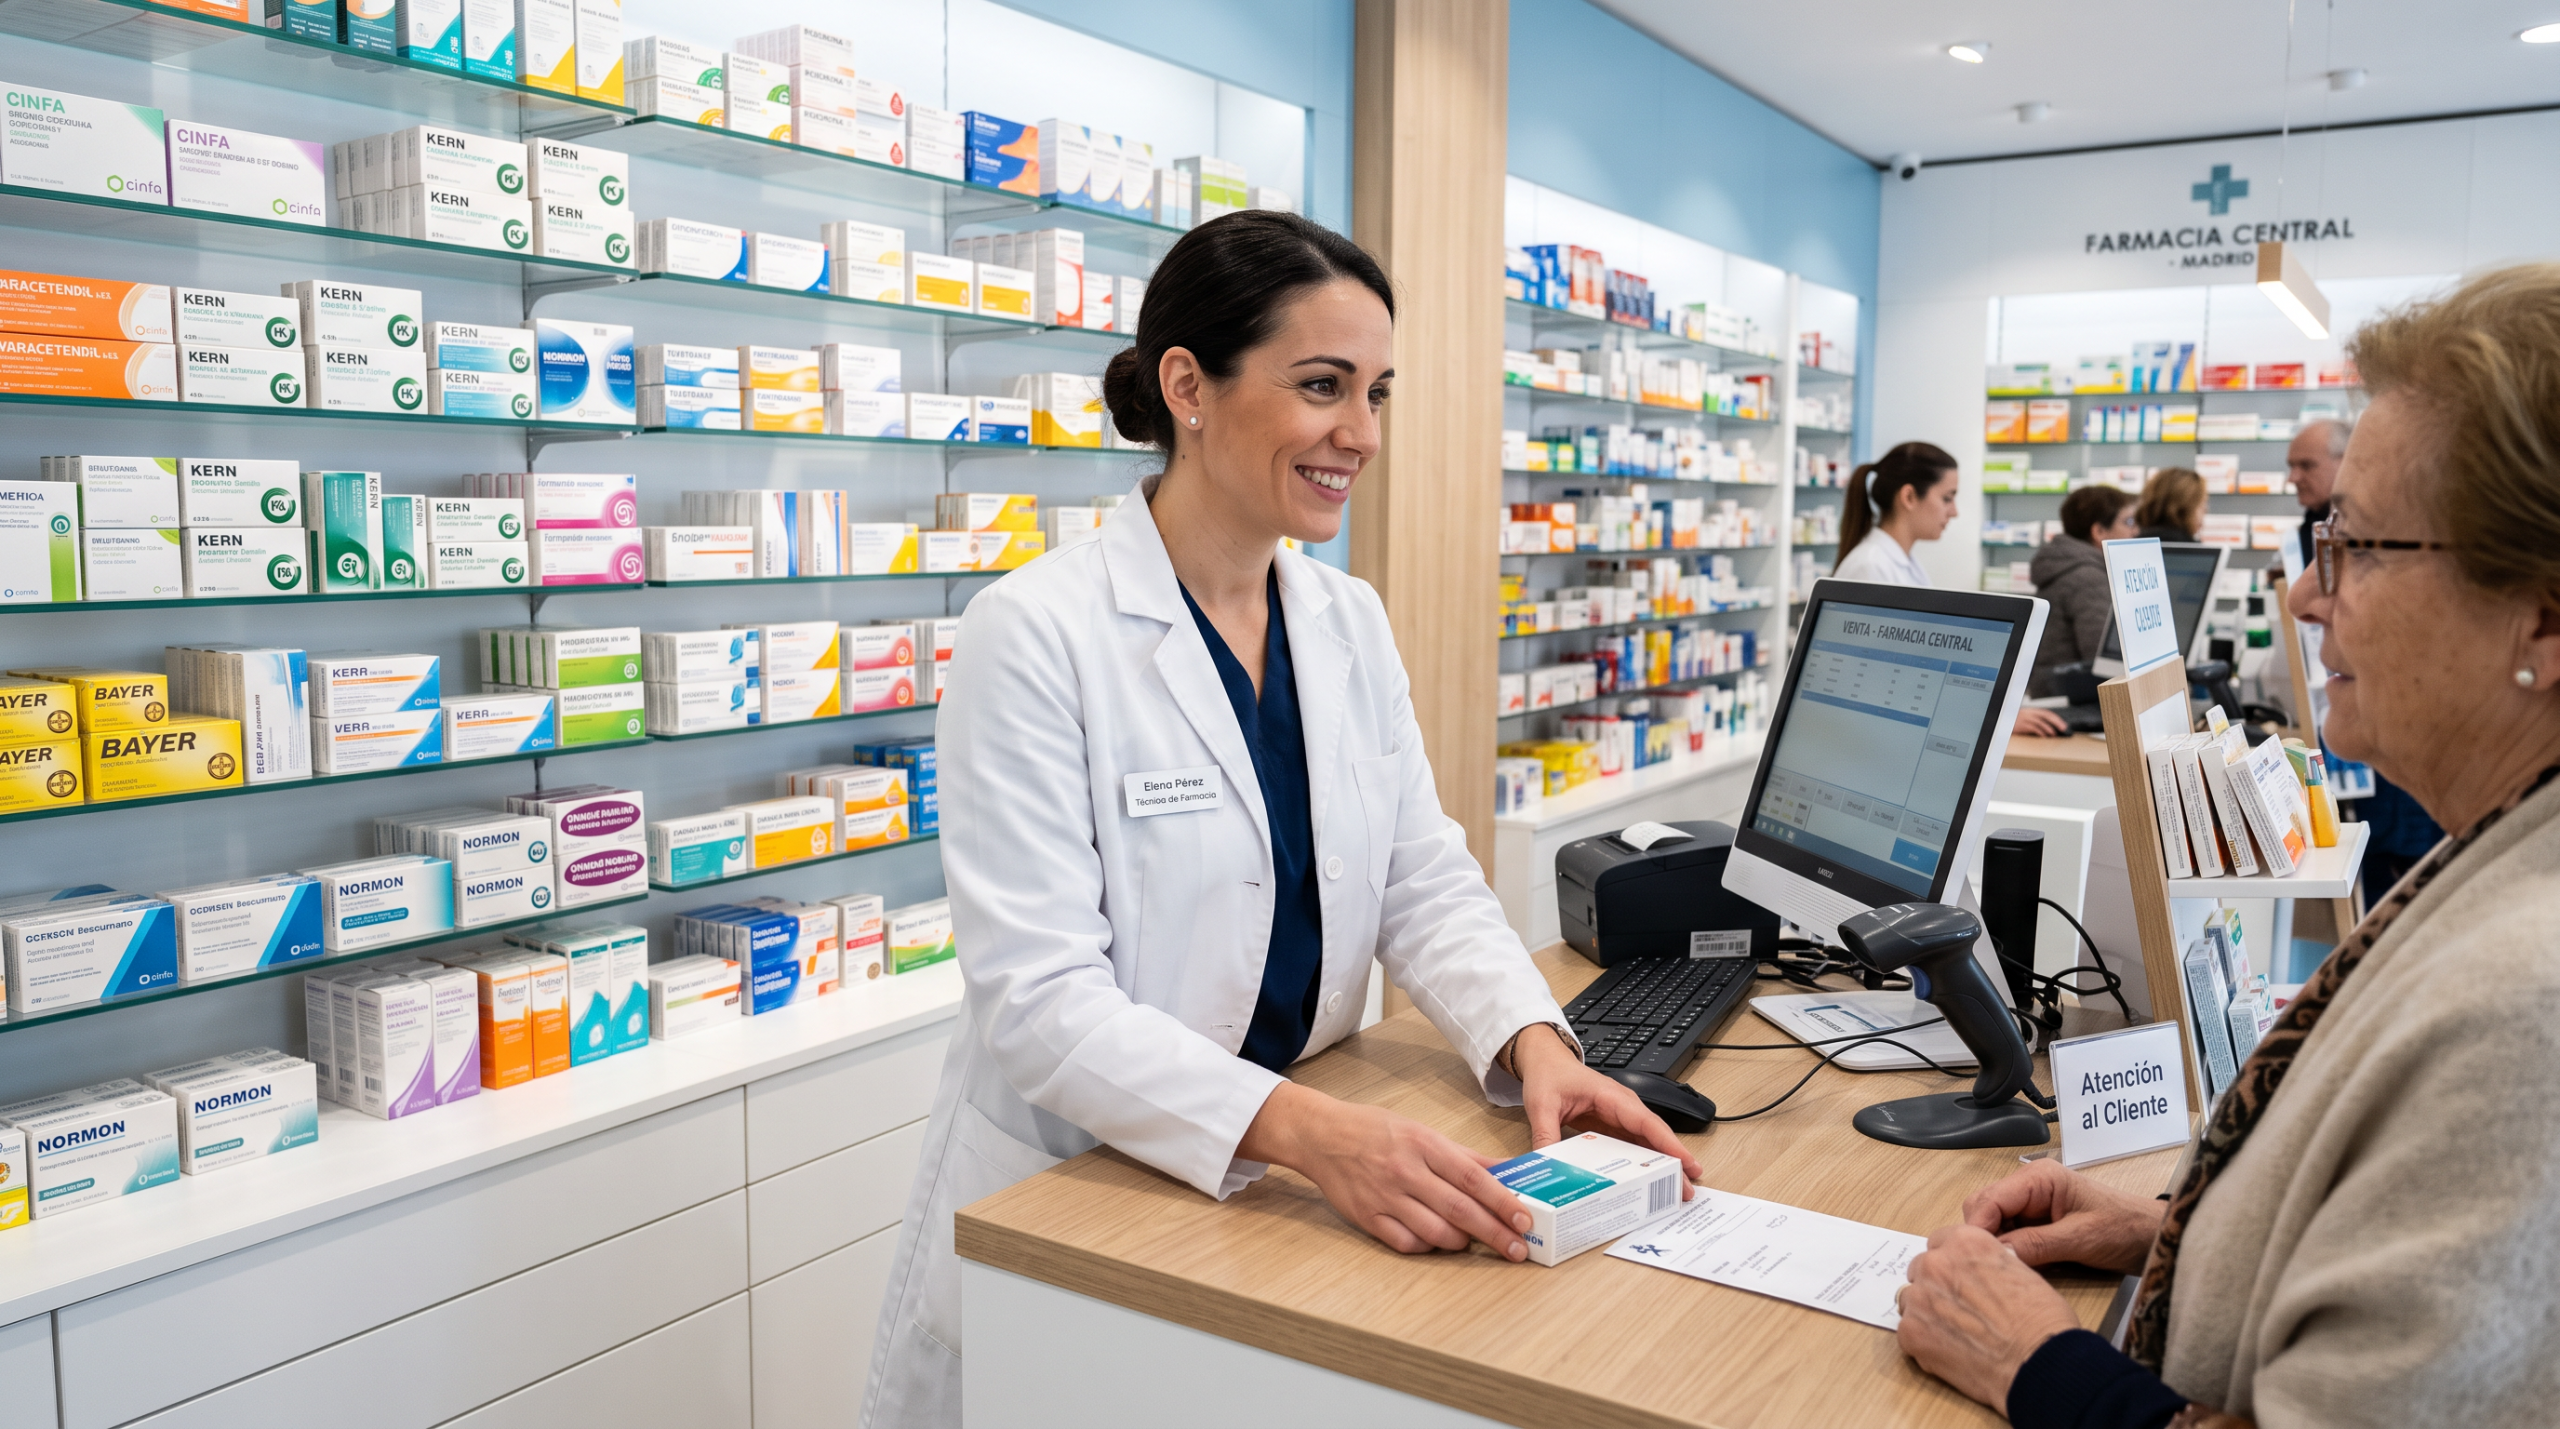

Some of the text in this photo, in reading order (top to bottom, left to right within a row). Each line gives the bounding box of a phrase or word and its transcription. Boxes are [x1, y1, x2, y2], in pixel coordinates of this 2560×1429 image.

[6, 91, 66, 114] CINFA
[177, 129, 230, 149] CINFA
[427, 133, 465, 150] KERN
[543, 145, 578, 161] KERN
[126, 179, 162, 194] cinfa
[431, 191, 469, 208] KERN
[289, 202, 321, 217] cinfa
[548, 205, 583, 220] KERN
[2085, 218, 2355, 253] FARMACIA CENTRAL
[2181, 252, 2255, 270] MADRID
[184, 293, 225, 308] KERN
[320, 287, 363, 302] KERN
[441, 325, 478, 338] KERN
[189, 351, 229, 365] KERN
[326, 352, 368, 366] KERN
[446, 372, 480, 384] KERN
[191, 465, 237, 477] KERN
[436, 503, 470, 513] KERN
[198, 535, 243, 547] KERN
[439, 547, 473, 557] KERN
[1843, 620, 1871, 637] VENTA
[1877, 625, 1926, 646] FARMACIA
[1928, 632, 1974, 652] CENTRAL
[94, 684, 154, 700] BAYER
[100, 732, 197, 759] BAYER
[1144, 778, 1204, 792] Elena Pérez
[1168, 795, 1179, 803] de
[463, 831, 520, 850] NORMON
[339, 876, 404, 896] NORMON
[467, 877, 523, 896] NORMON
[2081, 1060, 2164, 1096] Atención
[195, 1084, 272, 1114] NORMON
[2082, 1095, 2168, 1131] al Cliente
[38, 1120, 125, 1153] NORMON
